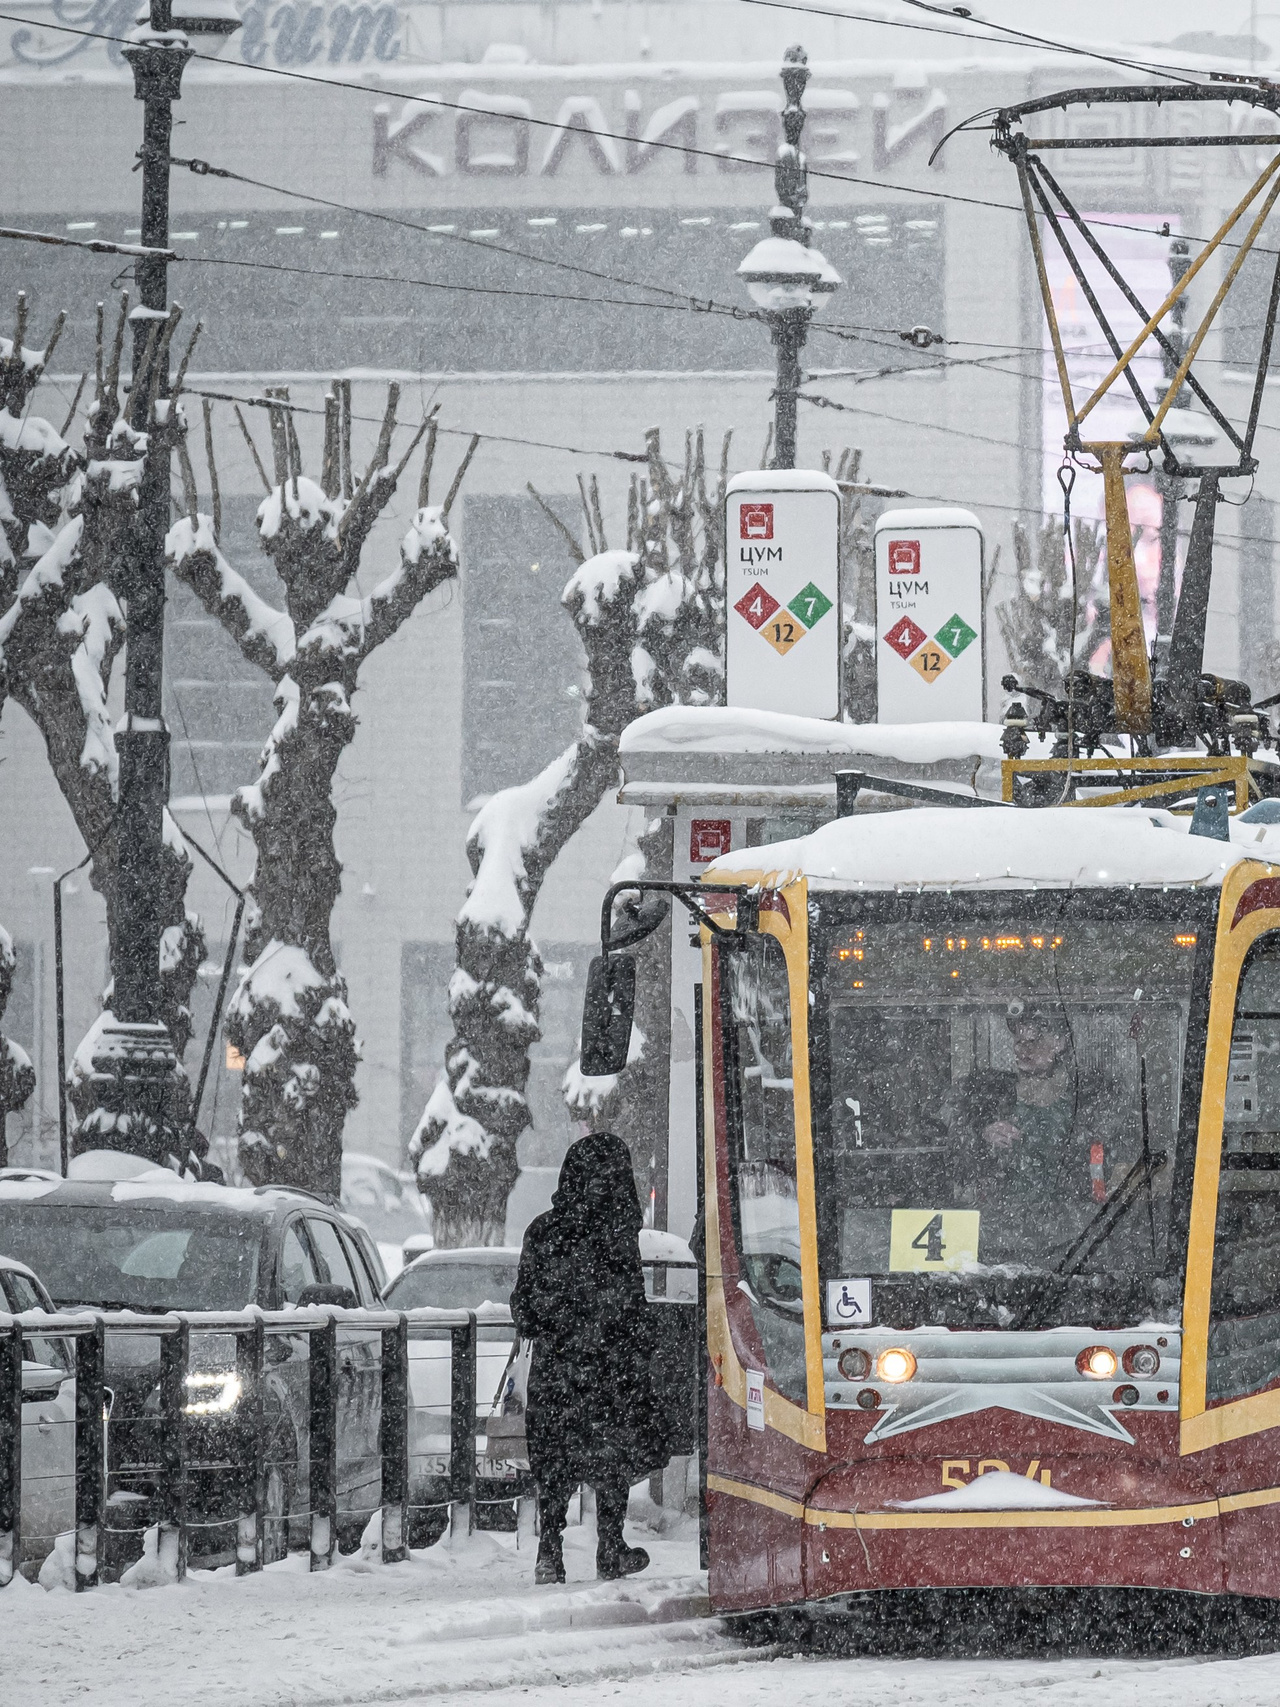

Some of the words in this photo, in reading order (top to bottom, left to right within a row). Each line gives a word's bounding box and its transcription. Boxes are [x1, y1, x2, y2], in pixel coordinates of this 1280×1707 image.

[371, 87, 947, 177] КОЛИЗЕЙ
[740, 546, 783, 565] ЦУМ
[742, 567, 769, 576] TSUM
[889, 581, 929, 598] ЦУМ
[749, 596, 763, 616] 4
[805, 597, 816, 618] 7
[890, 601, 917, 609] TSUM
[773, 624, 794, 642] 12
[898, 628, 912, 646] 4
[950, 628, 961, 646] 7
[921, 653, 941, 671] 12
[911, 1214, 947, 1261] 4
